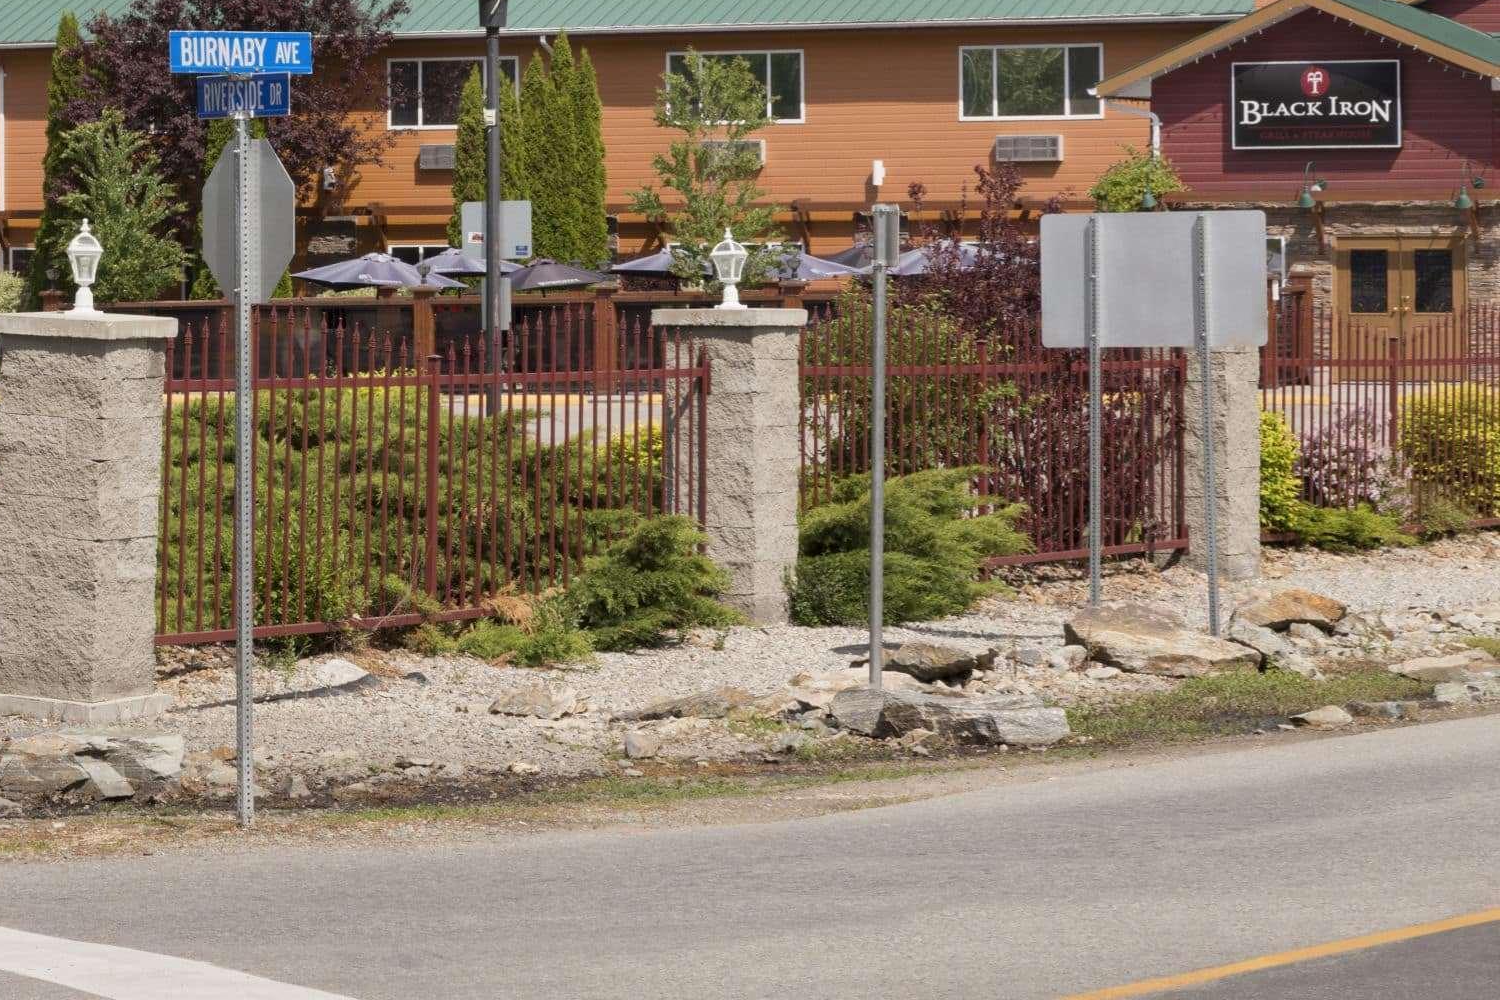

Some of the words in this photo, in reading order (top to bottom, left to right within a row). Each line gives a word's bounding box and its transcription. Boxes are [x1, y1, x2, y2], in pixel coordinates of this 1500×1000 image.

[181, 37, 268, 67] BURNABY
[275, 41, 301, 65] AVE
[203, 80, 265, 112] RIVERSIDE
[269, 82, 282, 106] DR
[1239, 100, 1323, 125] BLACK
[1328, 96, 1392, 123] IRON
